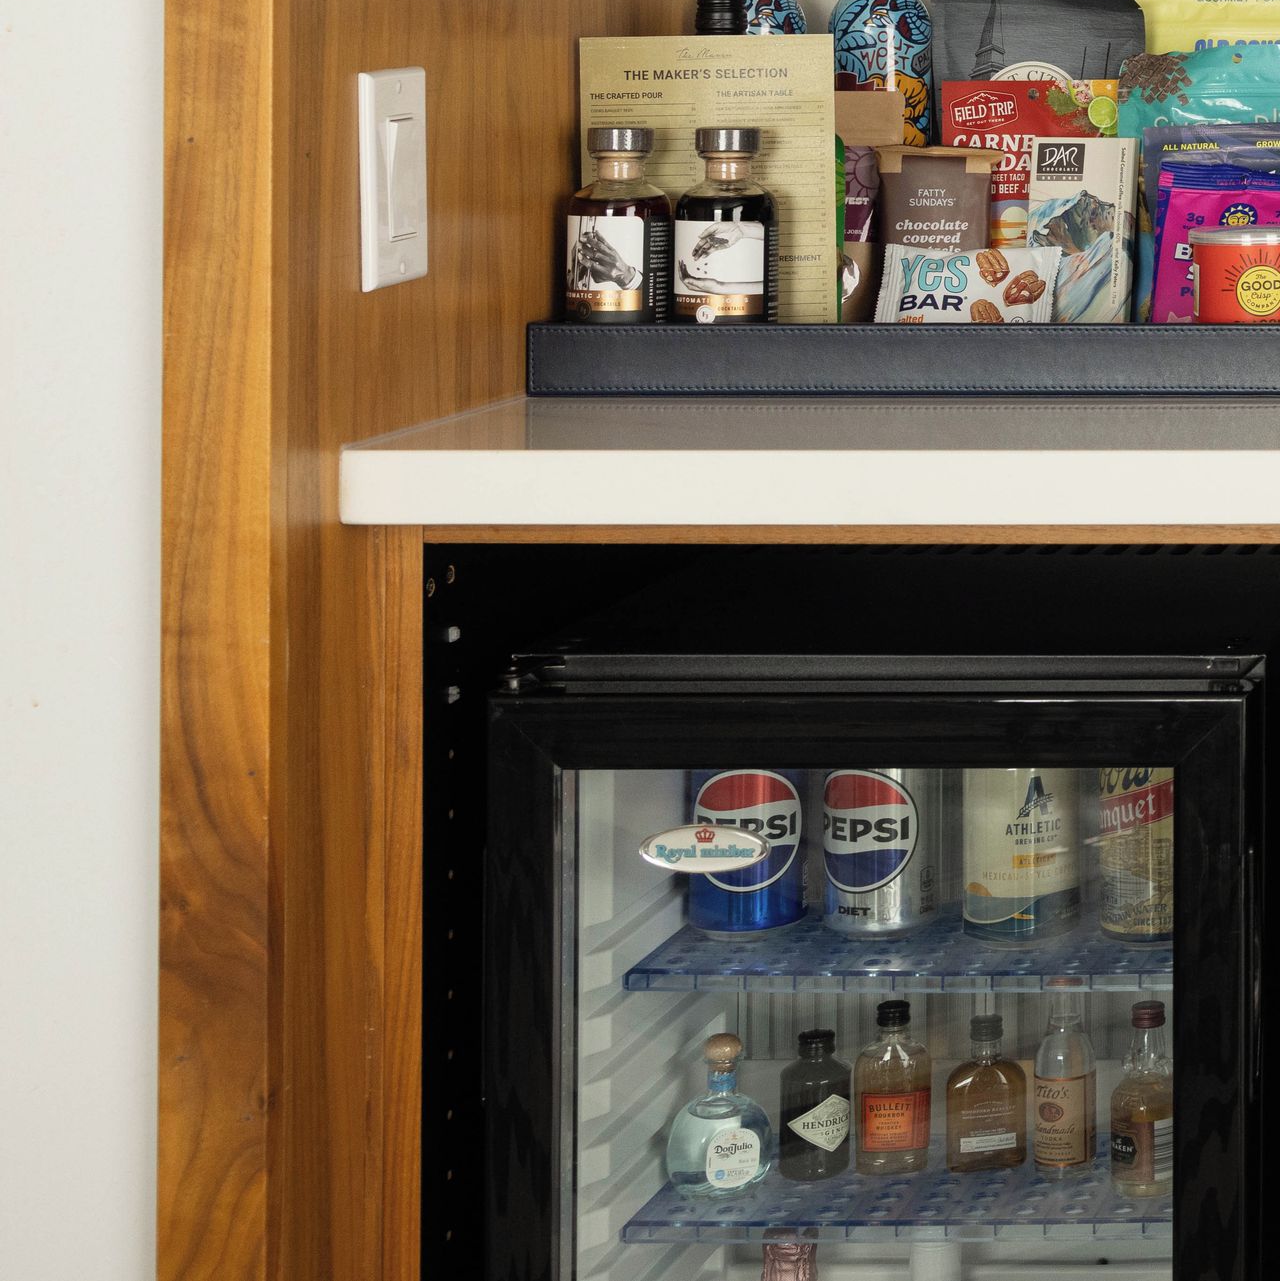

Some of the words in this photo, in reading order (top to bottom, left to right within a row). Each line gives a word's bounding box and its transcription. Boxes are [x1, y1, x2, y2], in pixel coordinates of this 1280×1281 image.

[623, 70, 649, 81] THE
[653, 69, 711, 80] MAKER'S
[715, 68, 788, 79] SELECTION
[606, 92, 640, 100] CRAFTED
[641, 91, 663, 99] POUR
[716, 90, 732, 98] THE
[769, 89, 793, 97] TABLE
[954, 104, 987, 122] FIELD
[1180, 142, 1220, 151] NATURAL
[1040, 145, 1079, 167] DAR
[1009, 173, 1025, 181] TACO
[918, 189, 946, 197] FATTY
[999, 184, 1019, 194] BEEF
[909, 198, 954, 207] SUNDAYS
[1186, 213, 1205, 225] 3g
[895, 219, 969, 231] chocolate
[903, 232, 961, 243] covered
[899, 294, 964, 313] BAR
[1246, 297, 1278, 309] COMPANY
[1005, 818, 1062, 836] ATHLETIC
[655, 845, 697, 864] Royal
[700, 845, 756, 858] minibar
[838, 906, 871, 916] DIET
[1036, 1085, 1068, 1099] Tito's
[869, 1103, 911, 1112] BULLEIT
